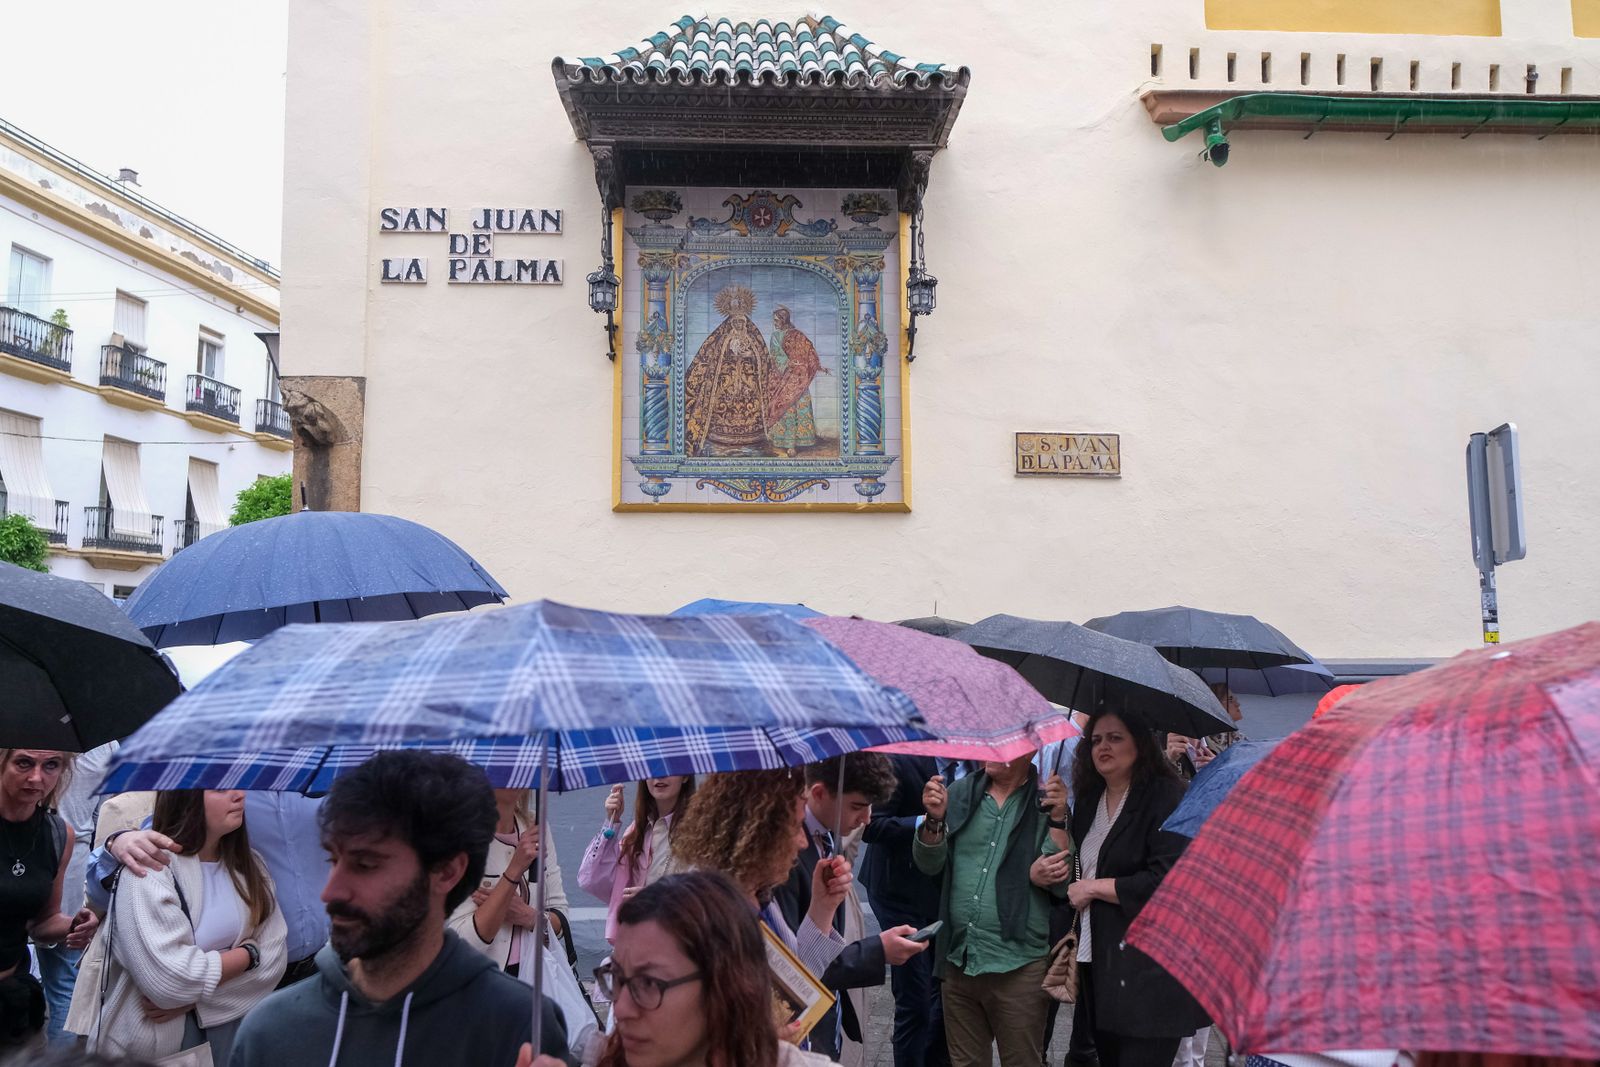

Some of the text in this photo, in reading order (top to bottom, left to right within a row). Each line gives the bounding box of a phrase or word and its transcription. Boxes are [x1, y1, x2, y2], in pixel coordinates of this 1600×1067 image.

[380, 207, 561, 232] SAN JUAN
[449, 233, 491, 255] DE
[382, 258, 561, 282] LA PALMA
